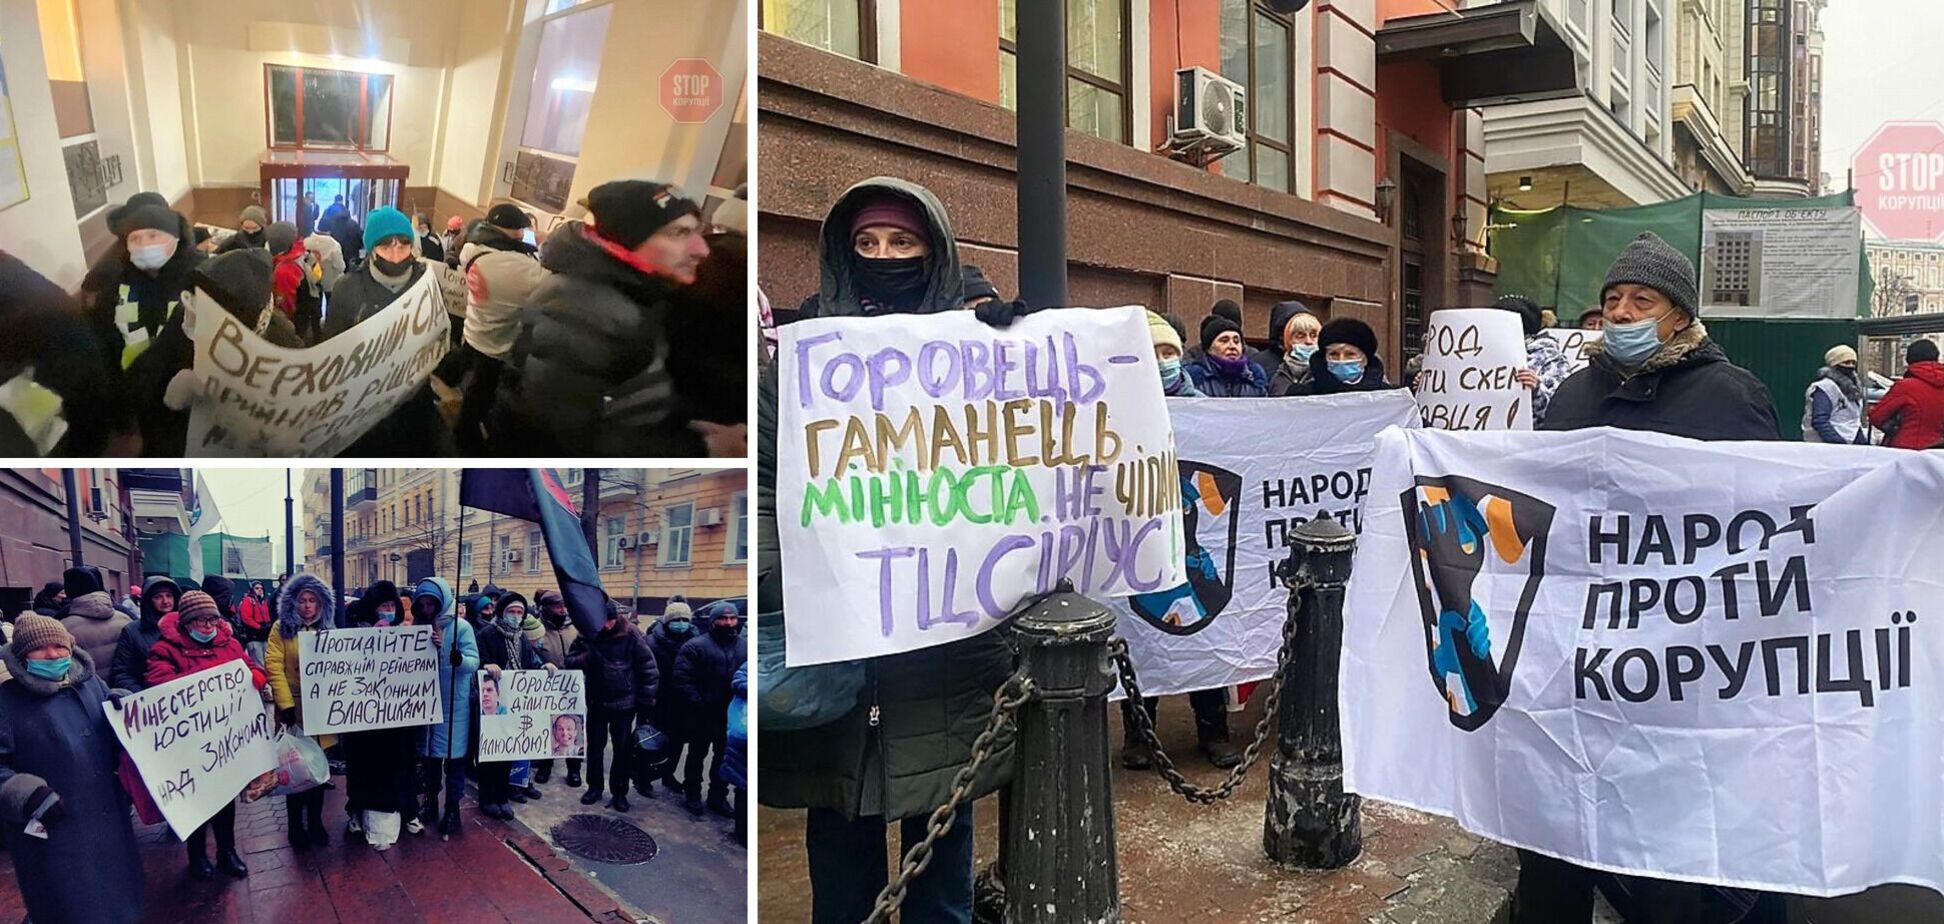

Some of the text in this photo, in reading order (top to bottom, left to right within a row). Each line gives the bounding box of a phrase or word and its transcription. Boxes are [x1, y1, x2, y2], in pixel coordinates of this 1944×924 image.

[804, 400, 1123, 478] ГАМАНЕЦЬ
[800, 460, 1041, 528] МІНЮСТА
[1055, 465, 1110, 520] НЕ
[1588, 503, 1818, 565] НАРОД
[1582, 554, 1812, 630] ПРОТИ
[310, 682, 320, 699] А
[328, 680, 347, 697] НЕ
[1574, 610, 1918, 707] КОРУПЦІЇ
[480, 728, 549, 757] АЛЮСКОЮ?
